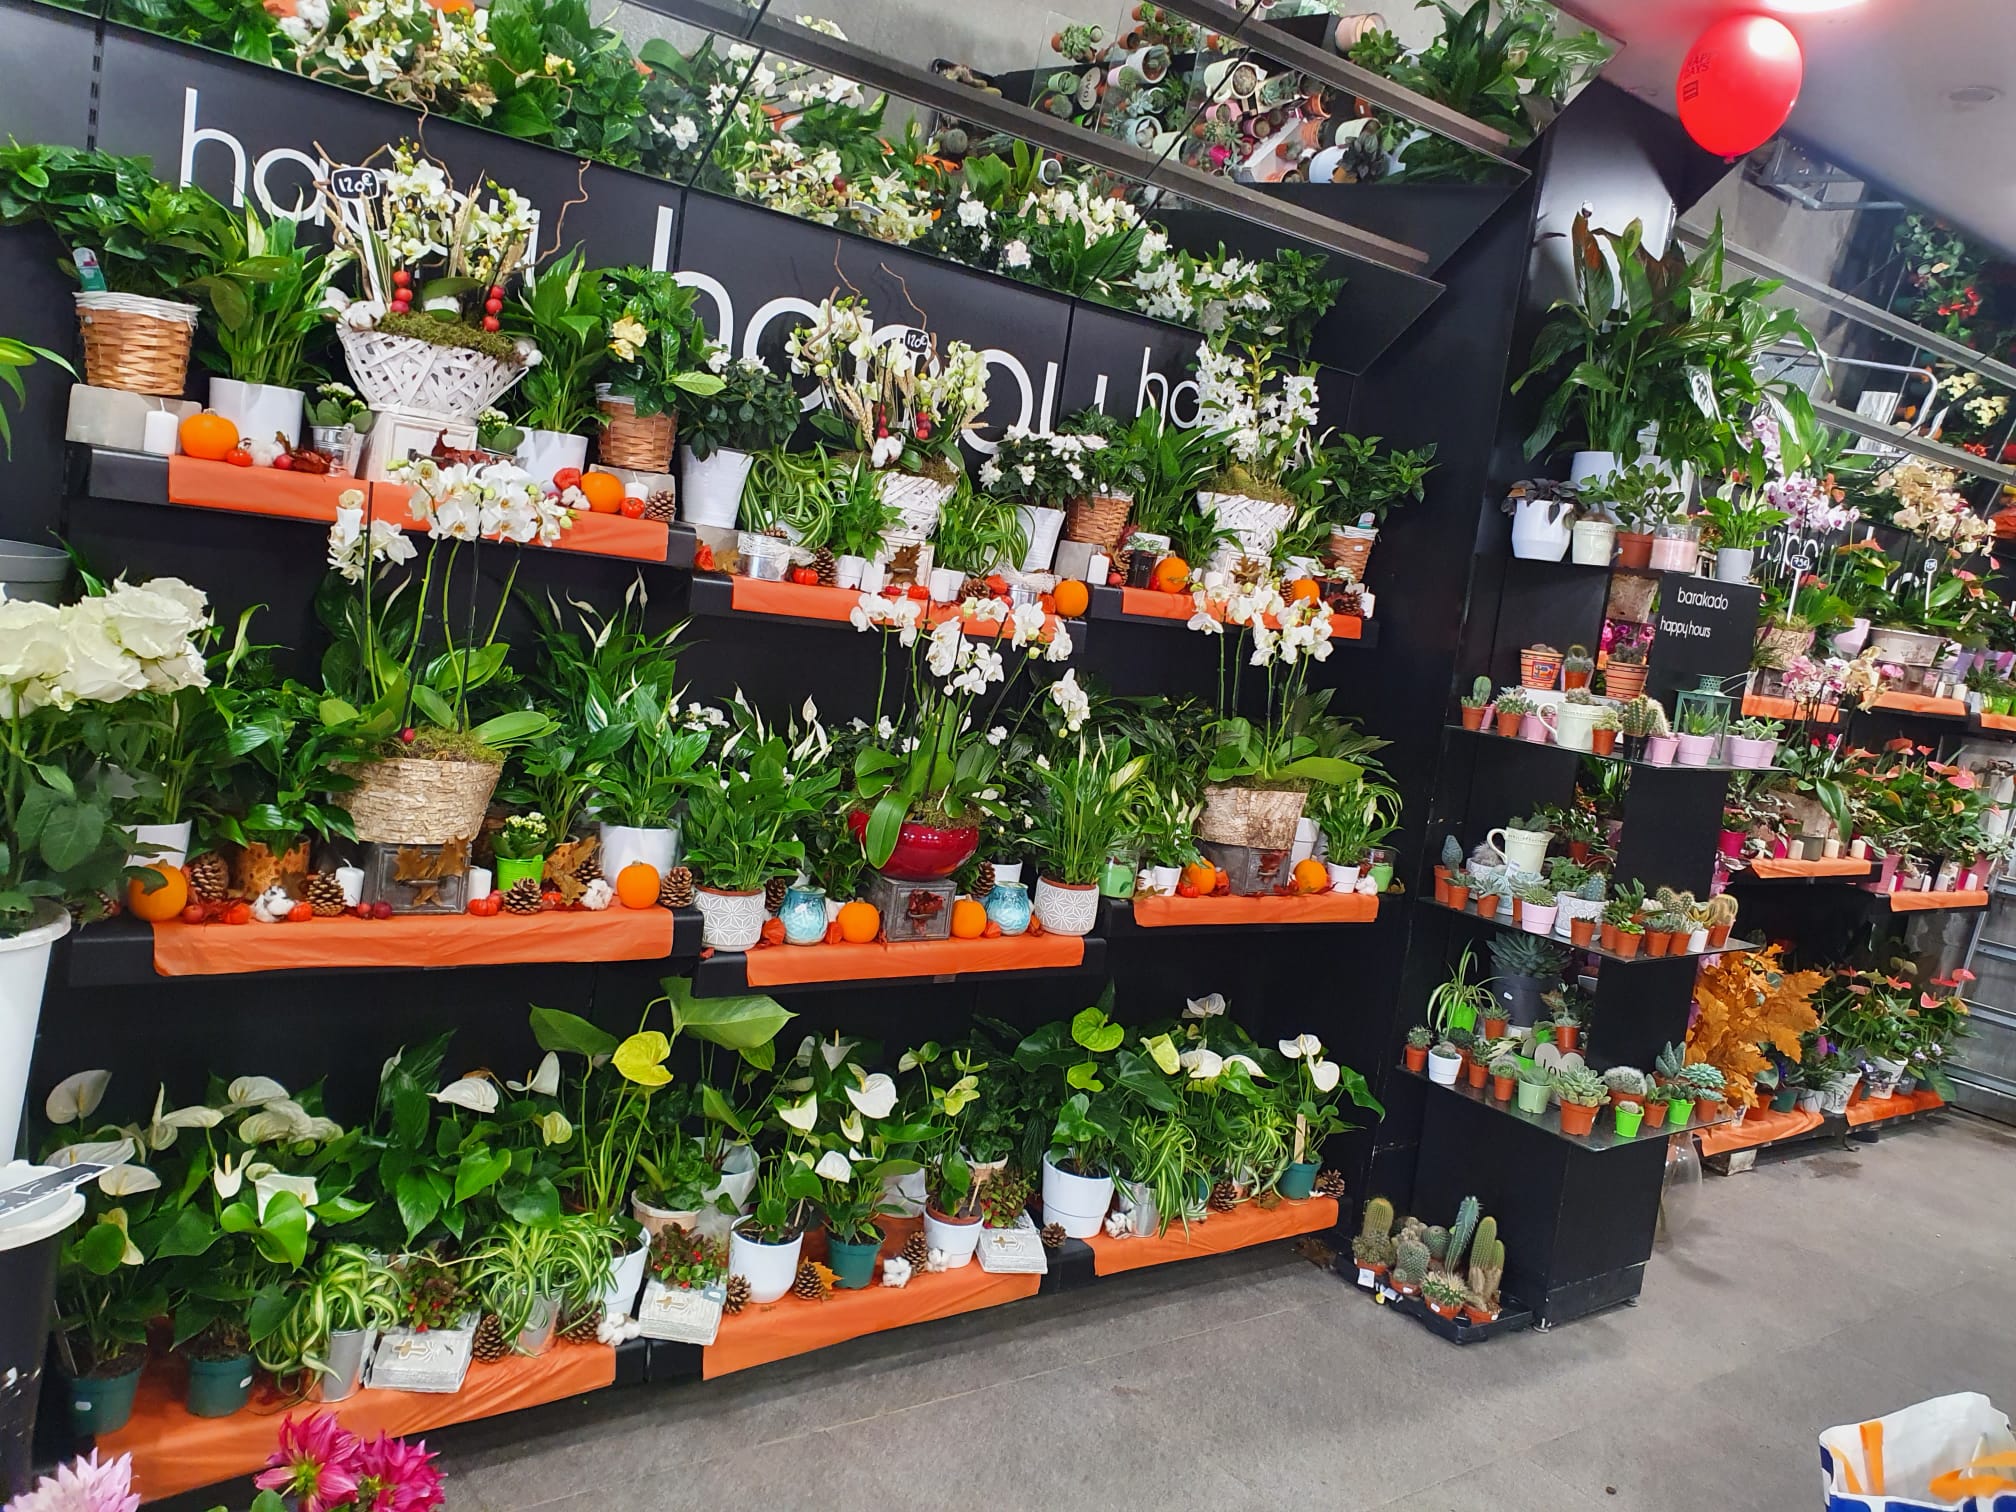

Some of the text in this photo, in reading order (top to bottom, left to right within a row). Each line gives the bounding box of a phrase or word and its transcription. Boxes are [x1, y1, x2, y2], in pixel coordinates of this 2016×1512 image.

[338, 172, 374, 193] 120€
[907, 333, 928, 349] 120€
[1677, 586, 1729, 611] barakado
[1660, 615, 1712, 638] happy hours
